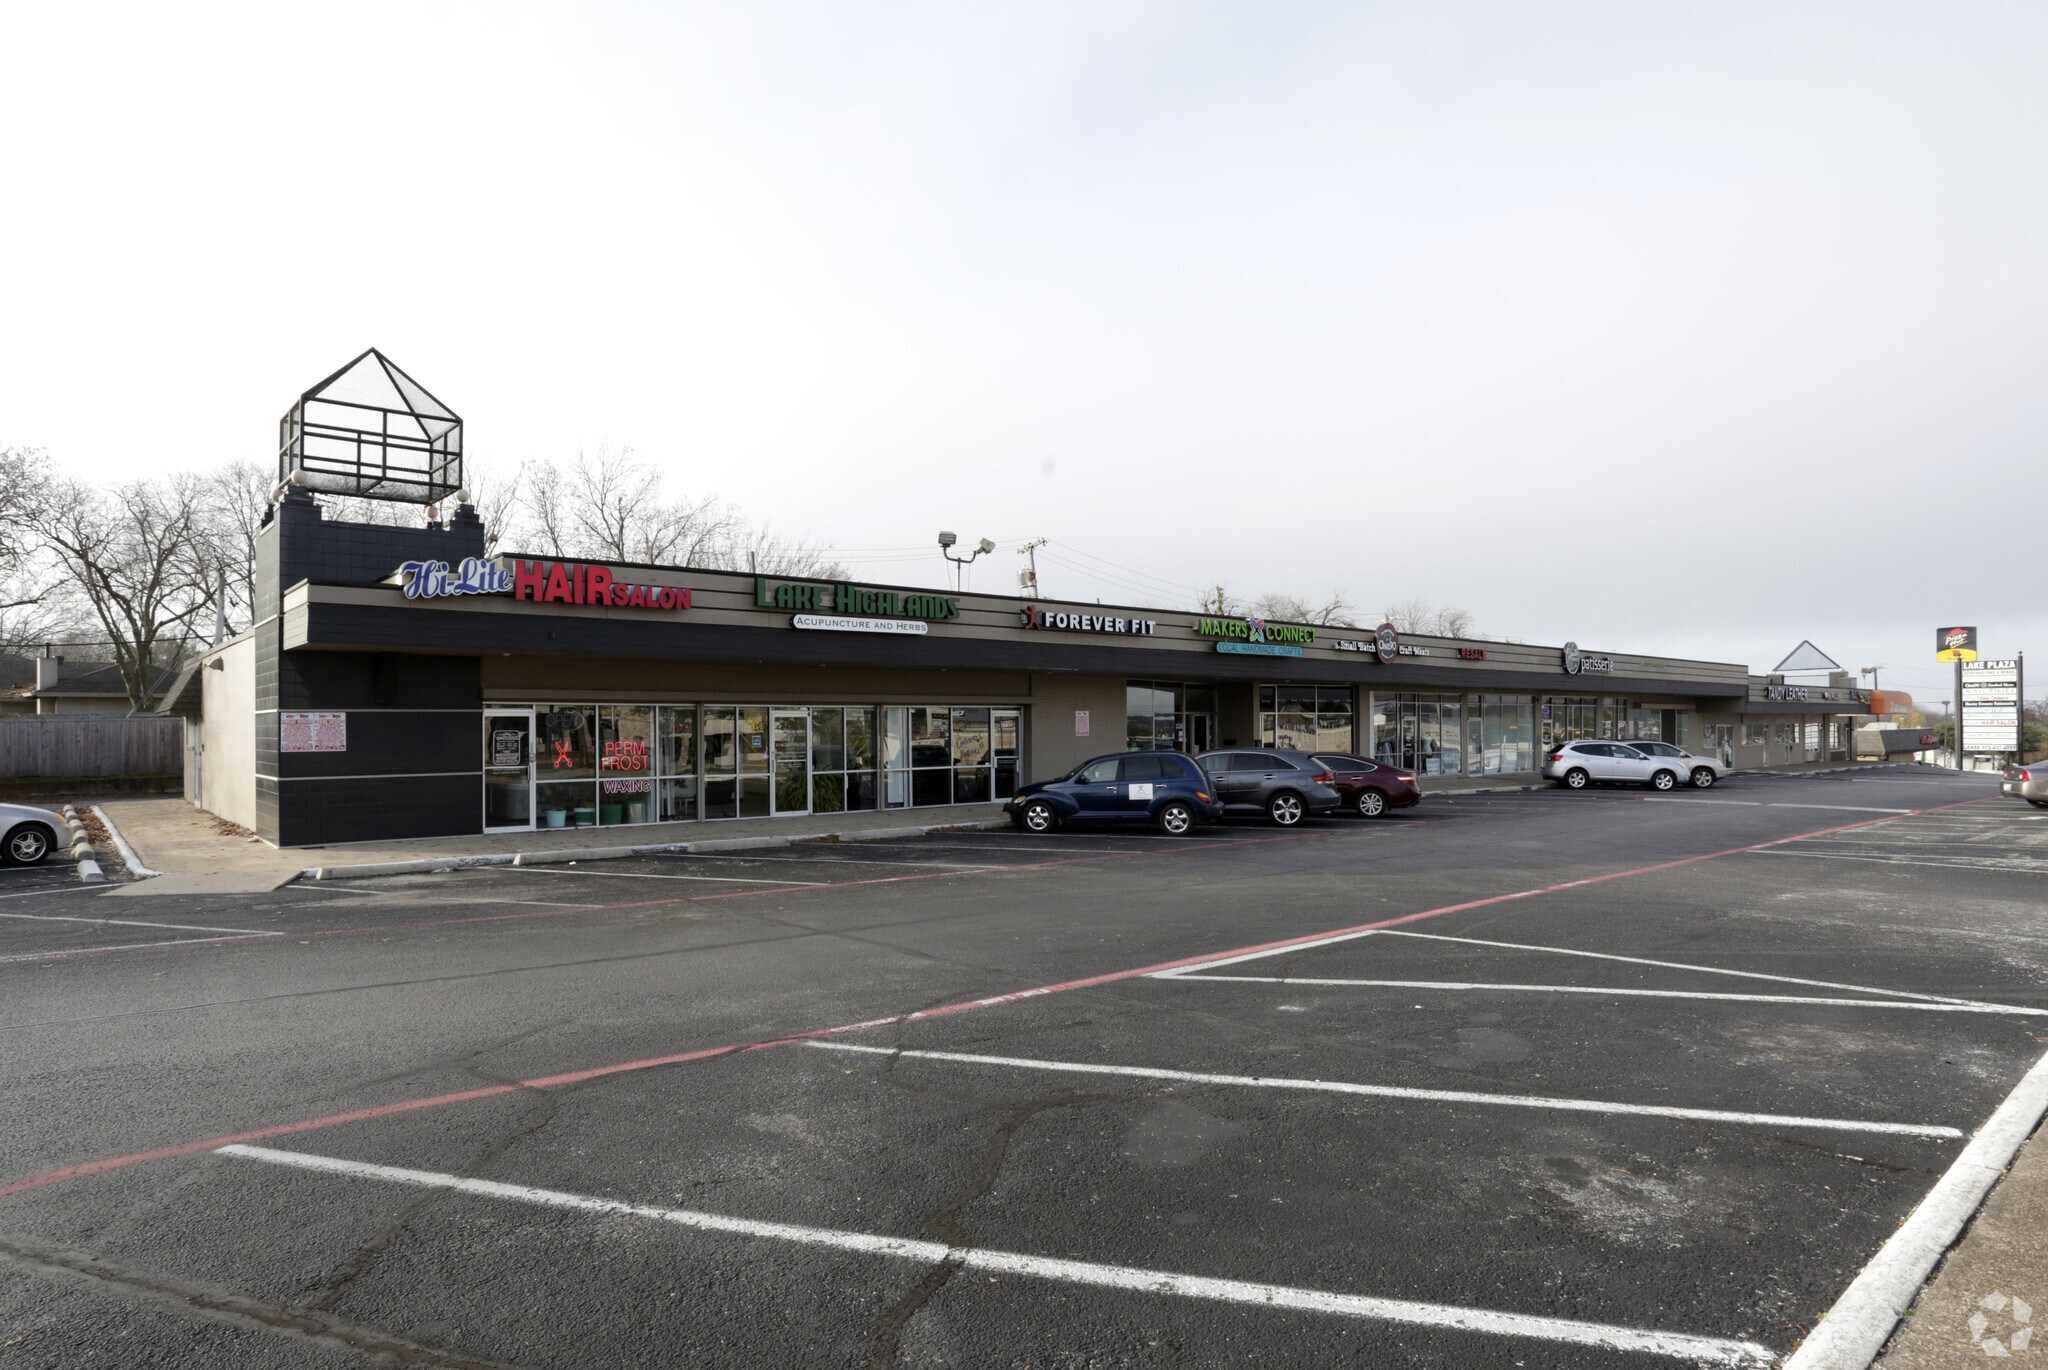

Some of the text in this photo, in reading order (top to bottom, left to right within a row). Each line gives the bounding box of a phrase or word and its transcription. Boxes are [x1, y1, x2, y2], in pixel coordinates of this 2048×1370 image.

[400, 557, 692, 610] Hi-Lite HAIR SALON
[756, 577, 961, 620] LAKE HIGHLANDS
[796, 616, 927, 632] ACUPUNCTURE AND HERBS
[1045, 611, 1156, 635] FOREVER FIT
[1201, 618, 1316, 643] MAKERS CONNECT
[1339, 641, 1377, 652] Small Batch
[1945, 633, 1968, 646] Pizza
[1218, 642, 1302, 656] LOCAL HANDMADE CRAFTS
[1461, 648, 1488, 661] RESALE
[1963, 660, 2016, 670] LAKE PLAZA
[1768, 686, 1786, 701] TANDY
[1786, 687, 1808, 701] LEATHER
[545, 713, 578, 729] OPEN
[604, 741, 646, 757] PERM
[602, 755, 649, 771] FROST
[603, 779, 651, 794] WAXING
